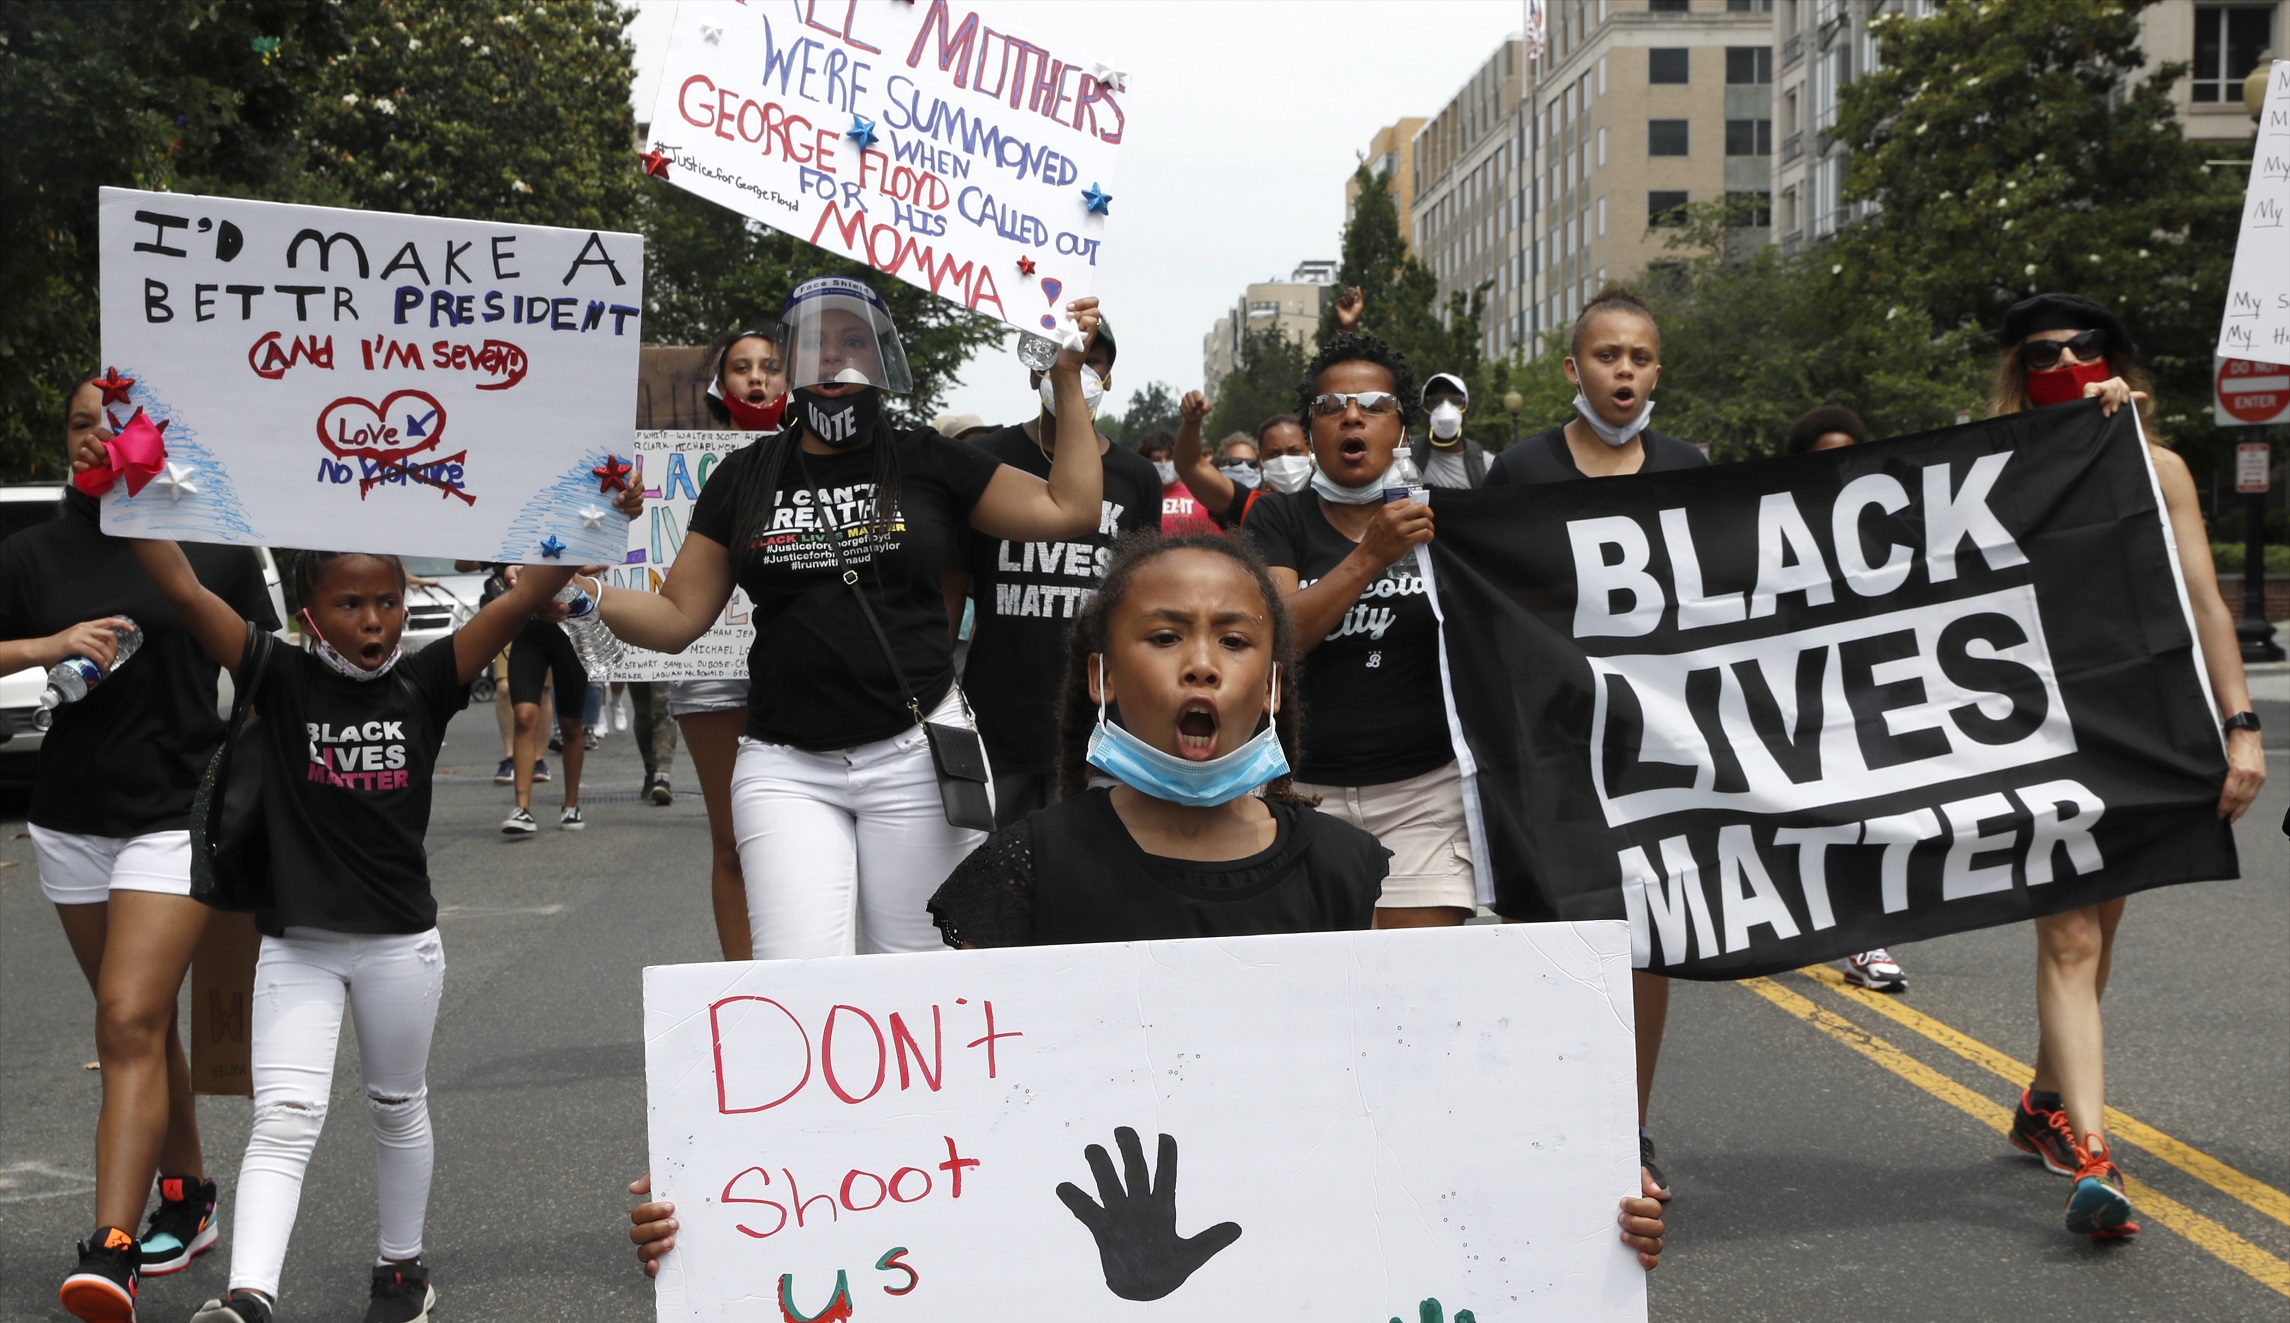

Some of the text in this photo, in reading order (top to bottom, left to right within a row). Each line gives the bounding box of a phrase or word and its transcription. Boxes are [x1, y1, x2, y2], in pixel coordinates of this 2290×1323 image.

[762, 13, 872, 120] WERE
[906, 0, 1125, 145] MOTHERS
[883, 75, 1078, 187] SUMMONED
[889, 130, 971, 180] WHEN
[678, 74, 1101, 267] GEORGE FLOYD CALLED OUT
[800, 165, 948, 237] FOR HIS
[2253, 199, 2283, 226] My
[133, 210, 627, 287] I'D MAKE A
[811, 200, 1007, 323] MOMMA
[800, 279, 869, 294] Face Shield
[144, 278, 640, 336] BETTR PRESIDENT
[2233, 291, 2262, 320] My
[361, 334, 425, 371] I'M
[2225, 325, 2252, 351] My
[2230, 361, 2279, 374] DO NOT
[2234, 394, 2277, 409] ENTER
[338, 417, 400, 446] Love
[677, 431, 713, 441] WALTER
[716, 432, 739, 441] SCOTT
[807, 403, 857, 441] VOTE
[643, 441, 669, 450] CLARK
[675, 441, 716, 452] MICHAEL
[774, 483, 879, 507] I CAN'T
[751, 534, 797, 549] LACK
[1565, 451, 2030, 638] BLACK
[998, 540, 1112, 578] LIVES
[736, 629, 754, 638] JEA
[690, 644, 734, 655] MICHAEL
[614, 672, 643, 681] PARKER
[624, 660, 658, 670] STEWART
[697, 660, 730, 669] DUBOSE
[1599, 611, 2049, 800] LIVES
[306, 721, 406, 743] BLACK
[309, 744, 406, 772] LIVES
[307, 762, 409, 791] MATTER
[1617, 778, 2106, 970] MATTER
[719, 1135, 980, 1240] Shoot
